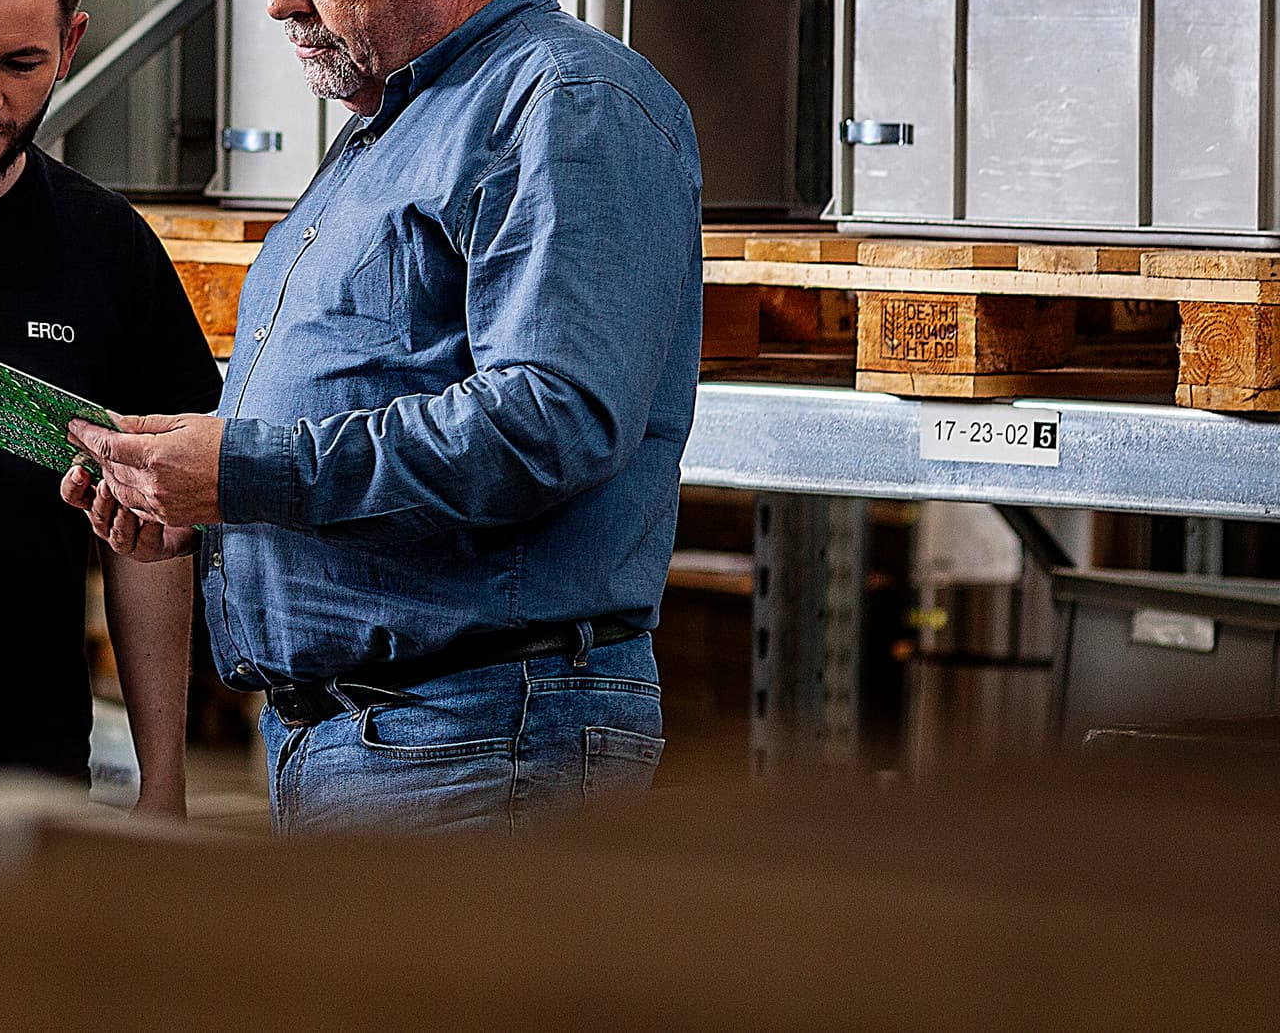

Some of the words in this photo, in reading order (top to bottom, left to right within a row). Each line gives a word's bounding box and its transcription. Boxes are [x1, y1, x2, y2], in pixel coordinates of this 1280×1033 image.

[906, 303, 955, 322] DE-TH1
[27, 321, 75, 343] ERCO
[906, 341, 929, 358] HT
[934, 341, 954, 358] DB
[935, 420, 1028, 445] 17-23-02
[1035, 422, 1055, 448] 5
